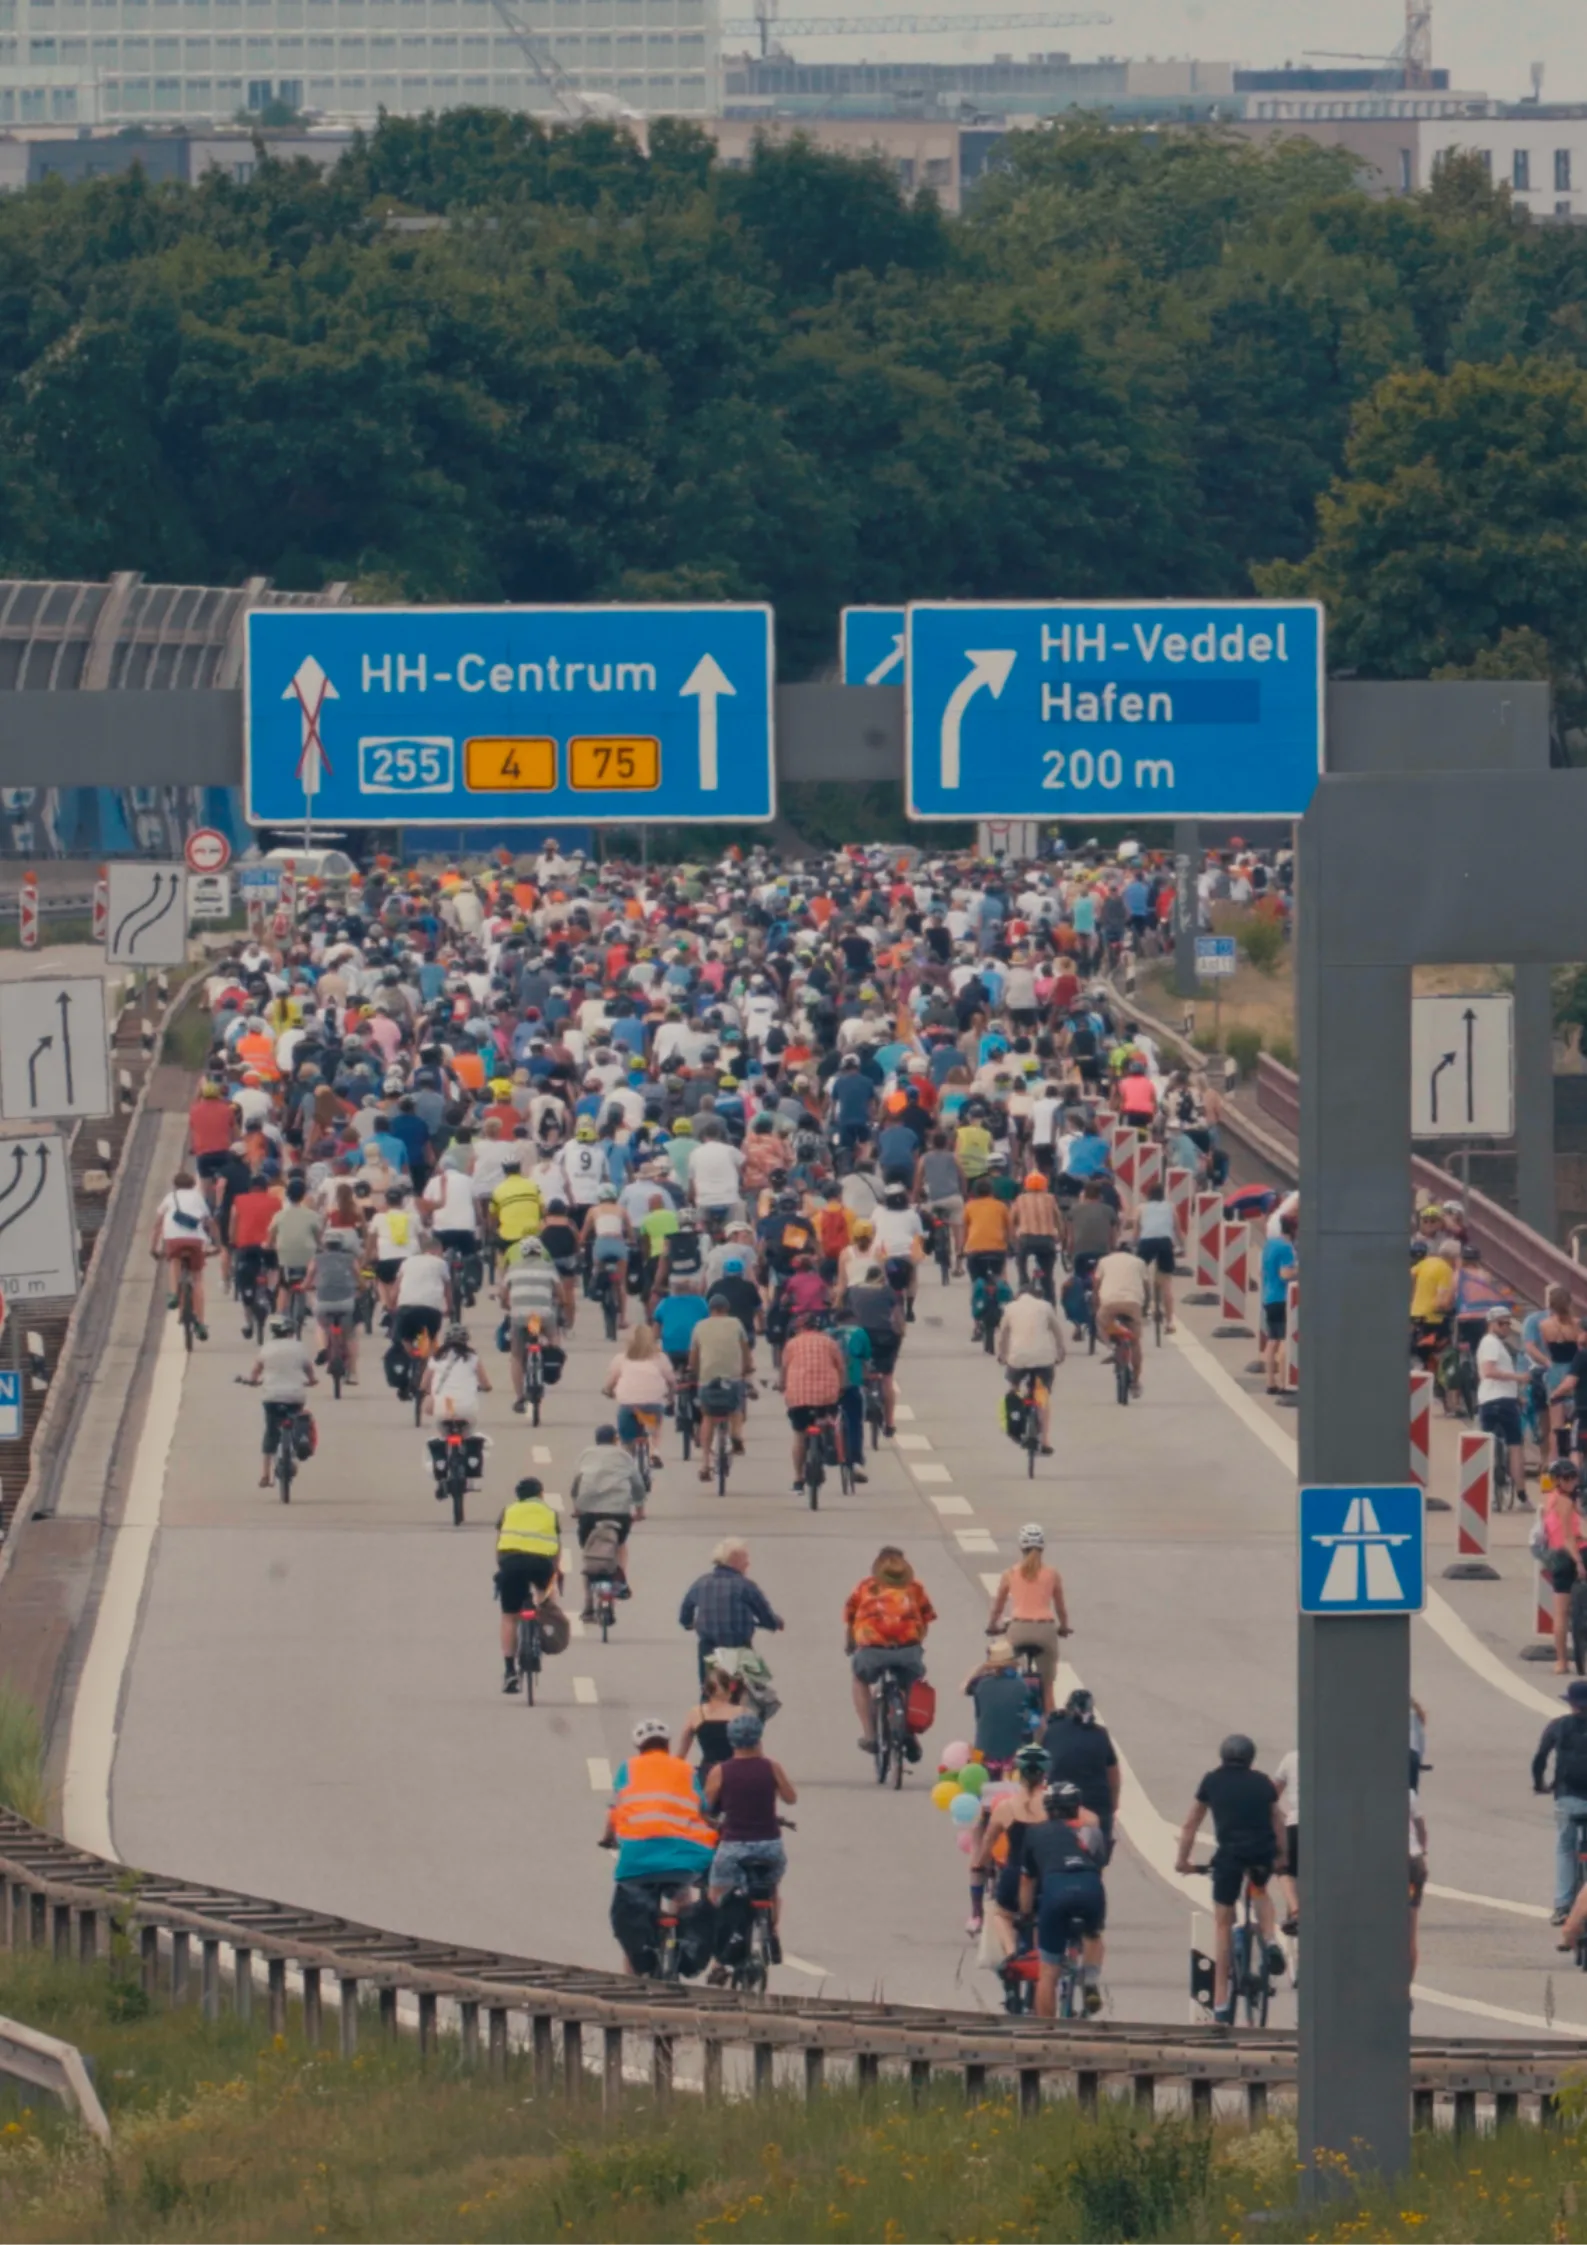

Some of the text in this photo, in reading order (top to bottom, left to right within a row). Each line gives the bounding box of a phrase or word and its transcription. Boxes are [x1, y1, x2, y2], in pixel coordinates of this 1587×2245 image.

[1040, 622, 1289, 663] HH-Veddel
[361, 652, 657, 694] HH-Centrum
[1041, 681, 1173, 723] Hafen
[372, 747, 441, 784] 255
[500, 747, 522, 781] 4
[592, 746, 636, 780] 75
[1041, 749, 1175, 790] 200 m
[580, 1150, 593, 1172] 9
